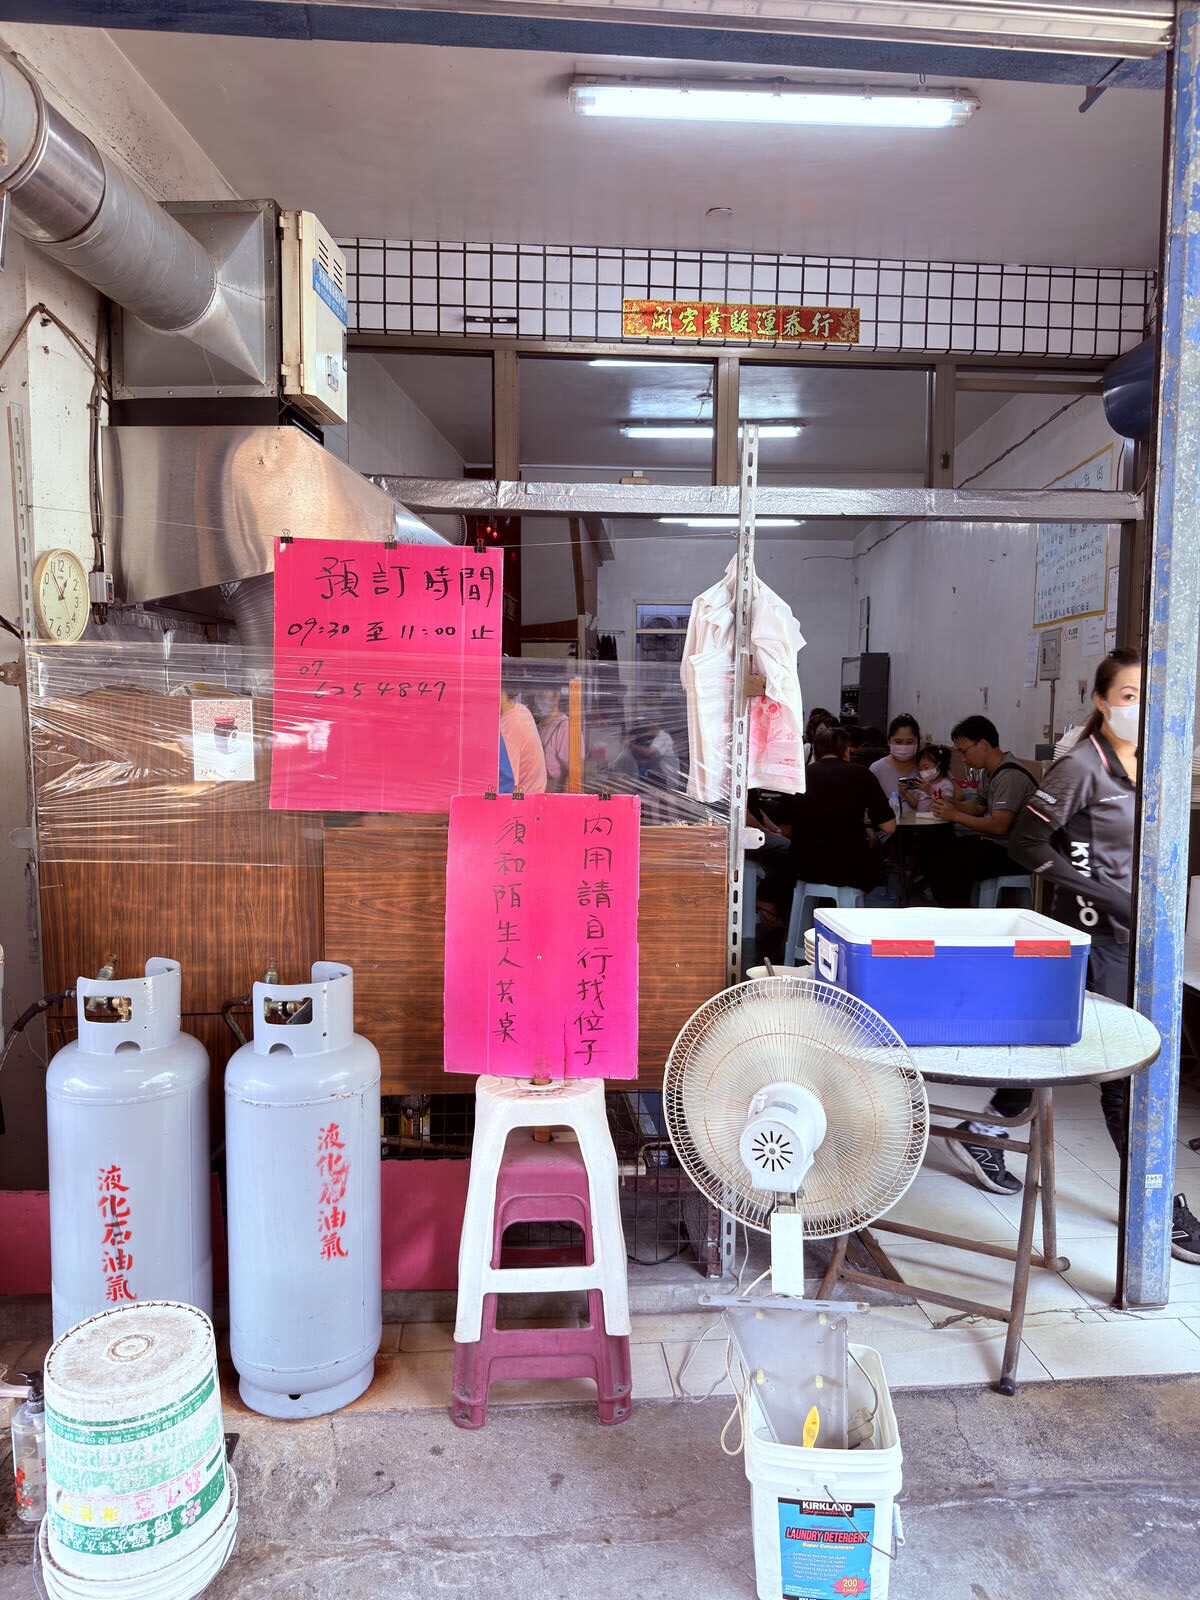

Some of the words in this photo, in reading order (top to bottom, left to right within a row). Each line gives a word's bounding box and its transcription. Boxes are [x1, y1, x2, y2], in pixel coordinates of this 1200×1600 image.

[314, 556, 495, 608] 預訂時間
[287, 617, 350, 647] 09:30
[365, 621, 390, 643] 至
[400, 624, 456, 640] 11:00
[470, 624, 496, 641] 止
[299, 660, 324, 677] 07
[491, 815, 527, 1045] 須和陌生人共桌
[314, 1121, 351, 1262] 液化石油氣
[97, 1164, 138, 1302] 液化石油氣
[802, 1500, 853, 1512] KIRKLAND
[785, 1526, 822, 1543] LAUNDRY
[823, 1529, 870, 1545] DETERGENT
[842, 1578, 858, 1587] 200
